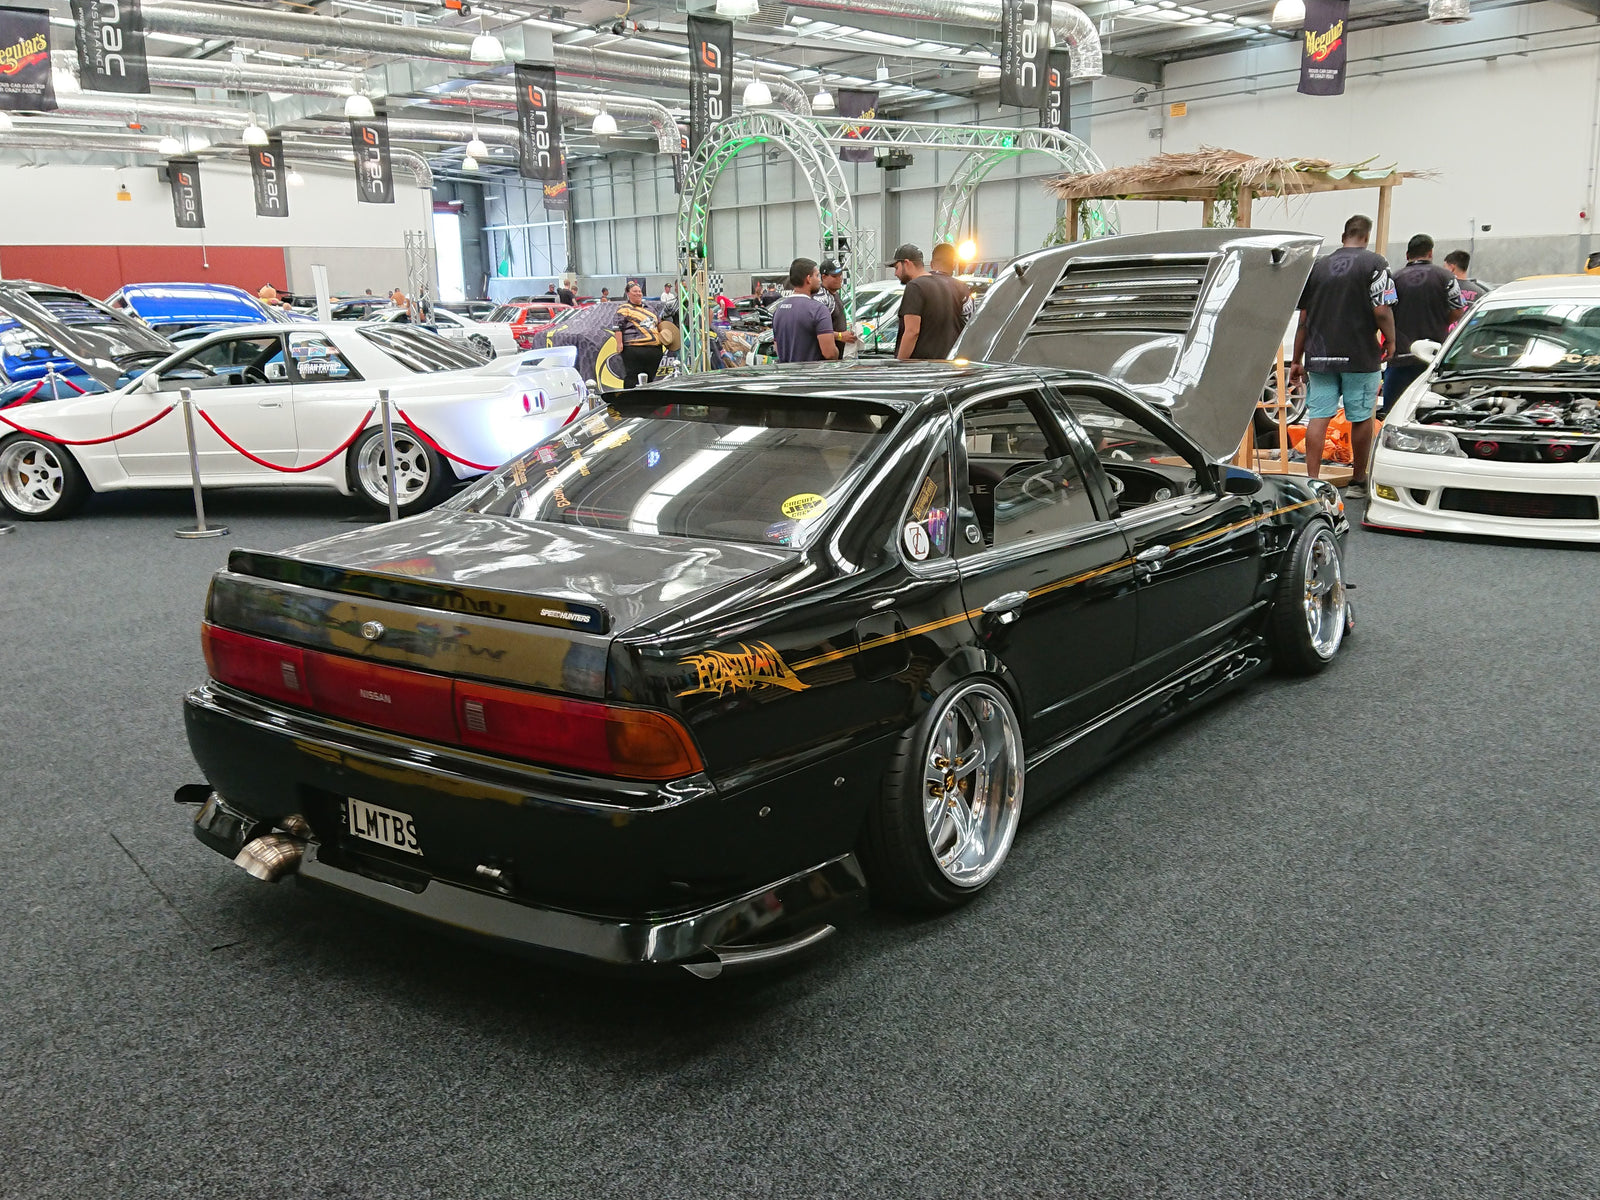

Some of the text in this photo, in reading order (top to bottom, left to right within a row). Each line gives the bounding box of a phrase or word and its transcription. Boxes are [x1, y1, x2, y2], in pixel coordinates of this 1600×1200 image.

[0, 33, 47, 73] eguiar's
[91, 0, 104, 75] NSURANCE
[100, 0, 126, 77] nac
[1015, 1, 1023, 85] NSURANCE
[1022, 0, 1039, 87] nac
[1305, 19, 1344, 59] Meguiar's
[1051, 90, 1061, 130] na
[529, 109, 539, 167] INSURANCE
[535, 110, 551, 168] nac
[266, 169, 280, 209] nac
[368, 147, 384, 194] nac
[184, 187, 196, 222] nac
[784, 496, 815, 508] CIRCUIT
[785, 499, 822, 514] JERK
[540, 608, 591, 623] SPEEDHUNTERS
[359, 688, 392, 704] NISSAN
[352, 803, 419, 850] LMTBS
